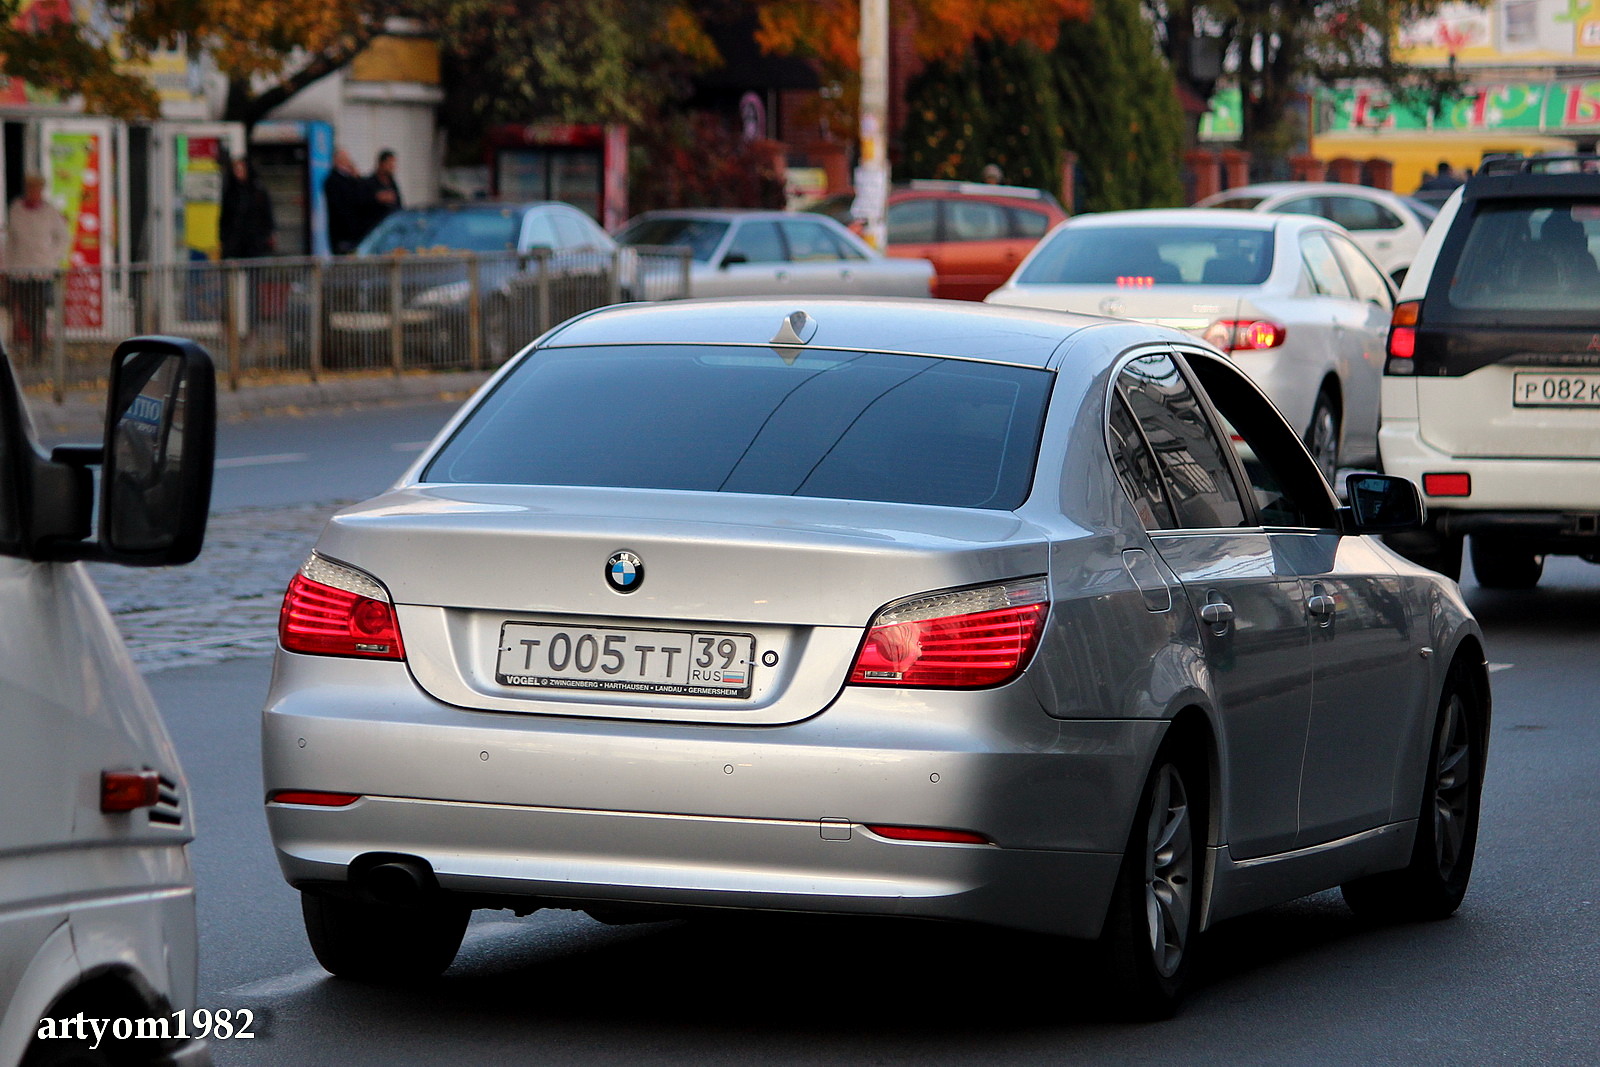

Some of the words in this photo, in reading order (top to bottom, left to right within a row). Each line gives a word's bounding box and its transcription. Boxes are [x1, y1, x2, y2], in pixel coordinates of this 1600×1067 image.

[608, 553, 641, 567] BMW
[696, 637, 737, 669] 39
[692, 669, 721, 682] RUS
[506, 675, 540, 686] VOGEL
[549, 680, 599, 688] ZWINGENBERG
[604, 683, 649, 691] HARTHAUSEN
[688, 687, 738, 696] GERMERSHEIM
